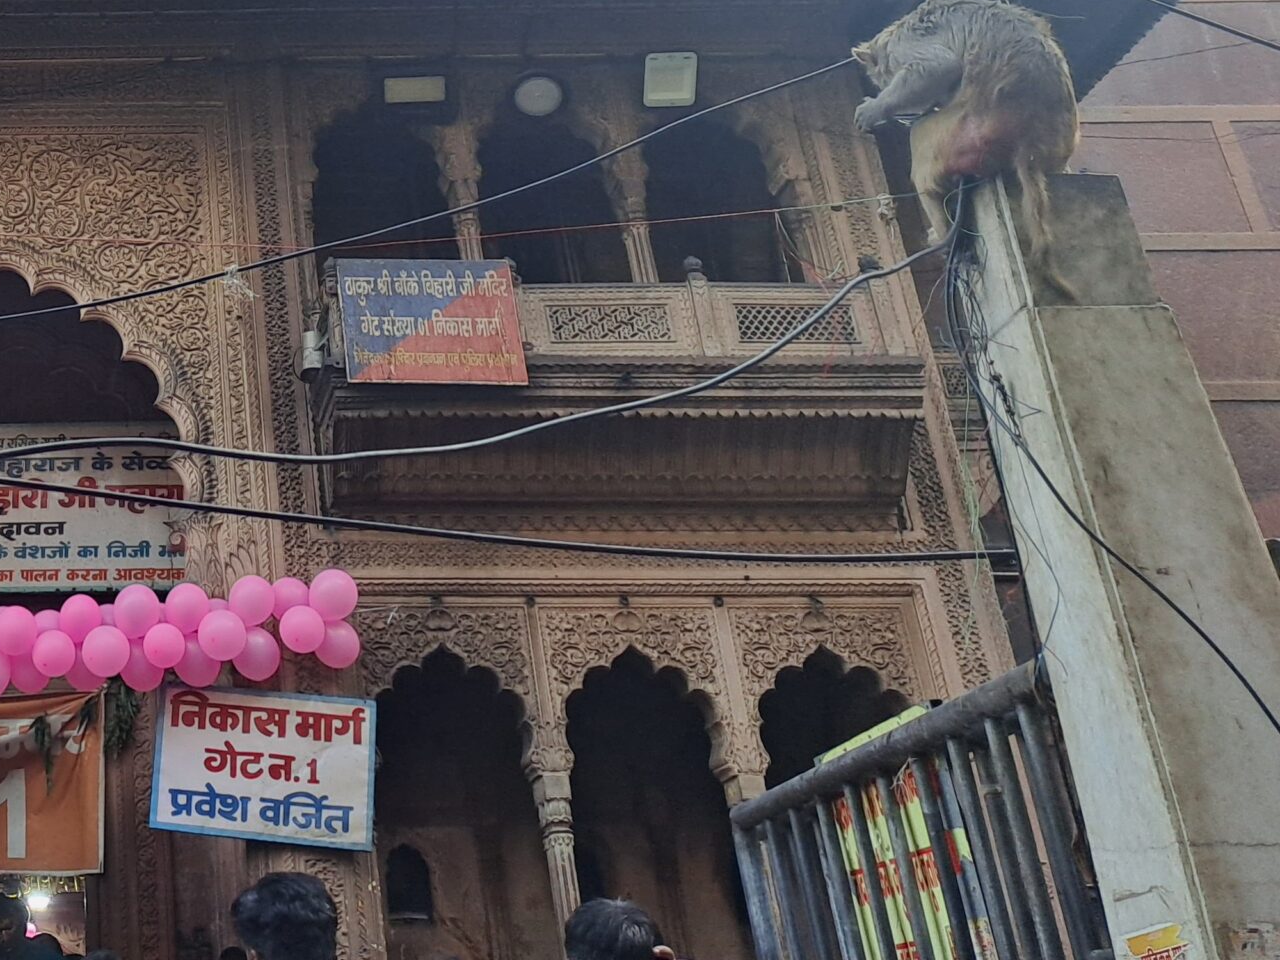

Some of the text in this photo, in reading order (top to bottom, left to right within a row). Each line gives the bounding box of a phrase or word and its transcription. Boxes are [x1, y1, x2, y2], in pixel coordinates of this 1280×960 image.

[344, 276, 375, 306] ठाकुर
[377, 269, 392, 296] श्री
[394, 270, 418, 296] बाँके
[421, 270, 457, 298] बिहारी
[458, 270, 476, 297] जी
[360, 310, 380, 335] गेट
[431, 309, 472, 337] निकास
[474, 310, 502, 337] मार्ग
[91, 451, 114, 471] के
[58, 476, 98, 510] जी
[14, 541, 71, 559] वंशजों
[77, 545, 99, 558] का
[106, 541, 151, 558] निजी
[21, 567, 61, 582] पालन
[67, 567, 108, 582] करना
[113, 567, 185, 583] आवश्यक
[171, 691, 365, 745] निकास मार्ग
[204, 740, 264, 779] गेट
[168, 782, 353, 834] प्रवेश वर्जित
